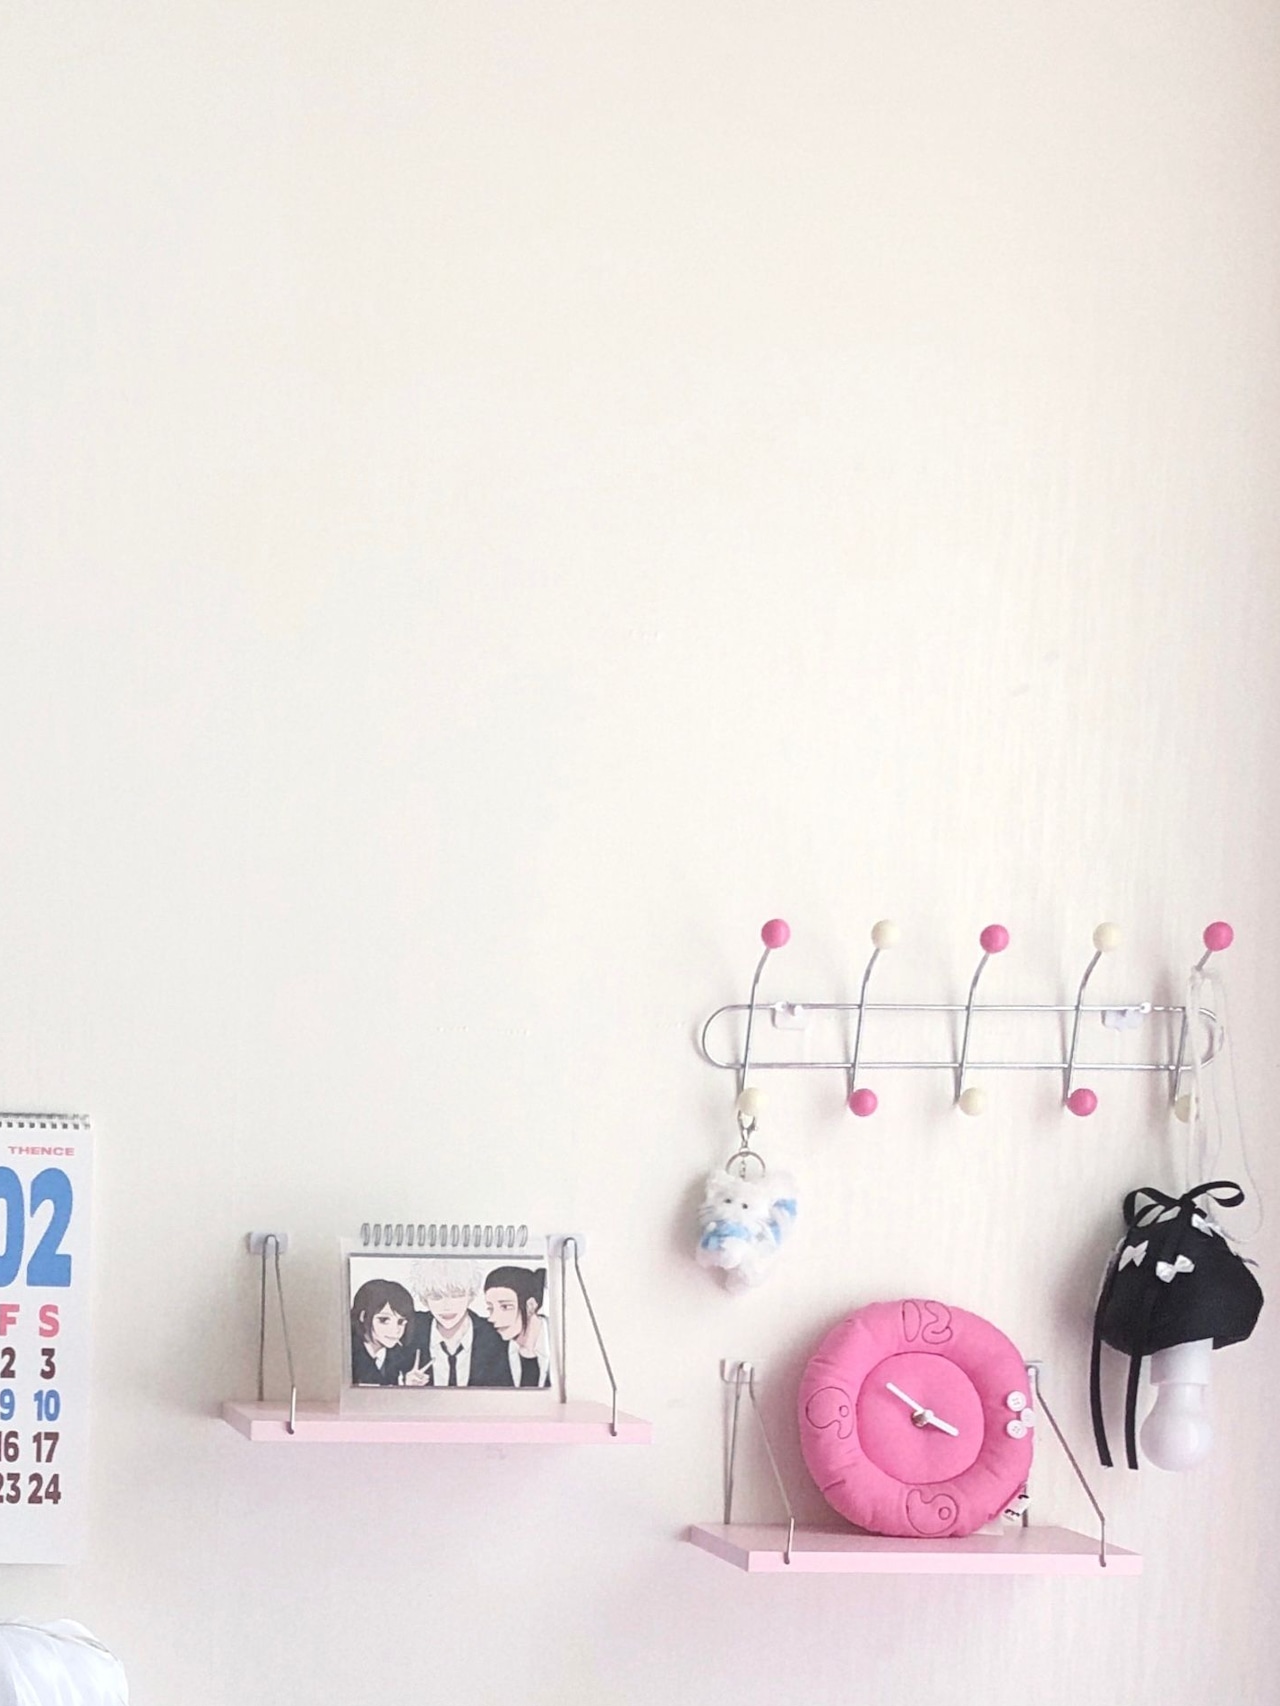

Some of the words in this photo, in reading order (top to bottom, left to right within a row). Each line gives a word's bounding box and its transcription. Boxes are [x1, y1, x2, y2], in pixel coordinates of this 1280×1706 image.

[8, 1146, 75, 1156] THENCE
[0, 1304, 20, 1337] F
[39, 1305, 60, 1338] S
[0, 1347, 17, 1379] 2
[39, 1348, 56, 1380] 3
[0, 1389, 16, 1421] 9
[34, 1390, 61, 1422] 10
[33, 1432, 60, 1464] 17
[27, 1473, 62, 1505] 24
